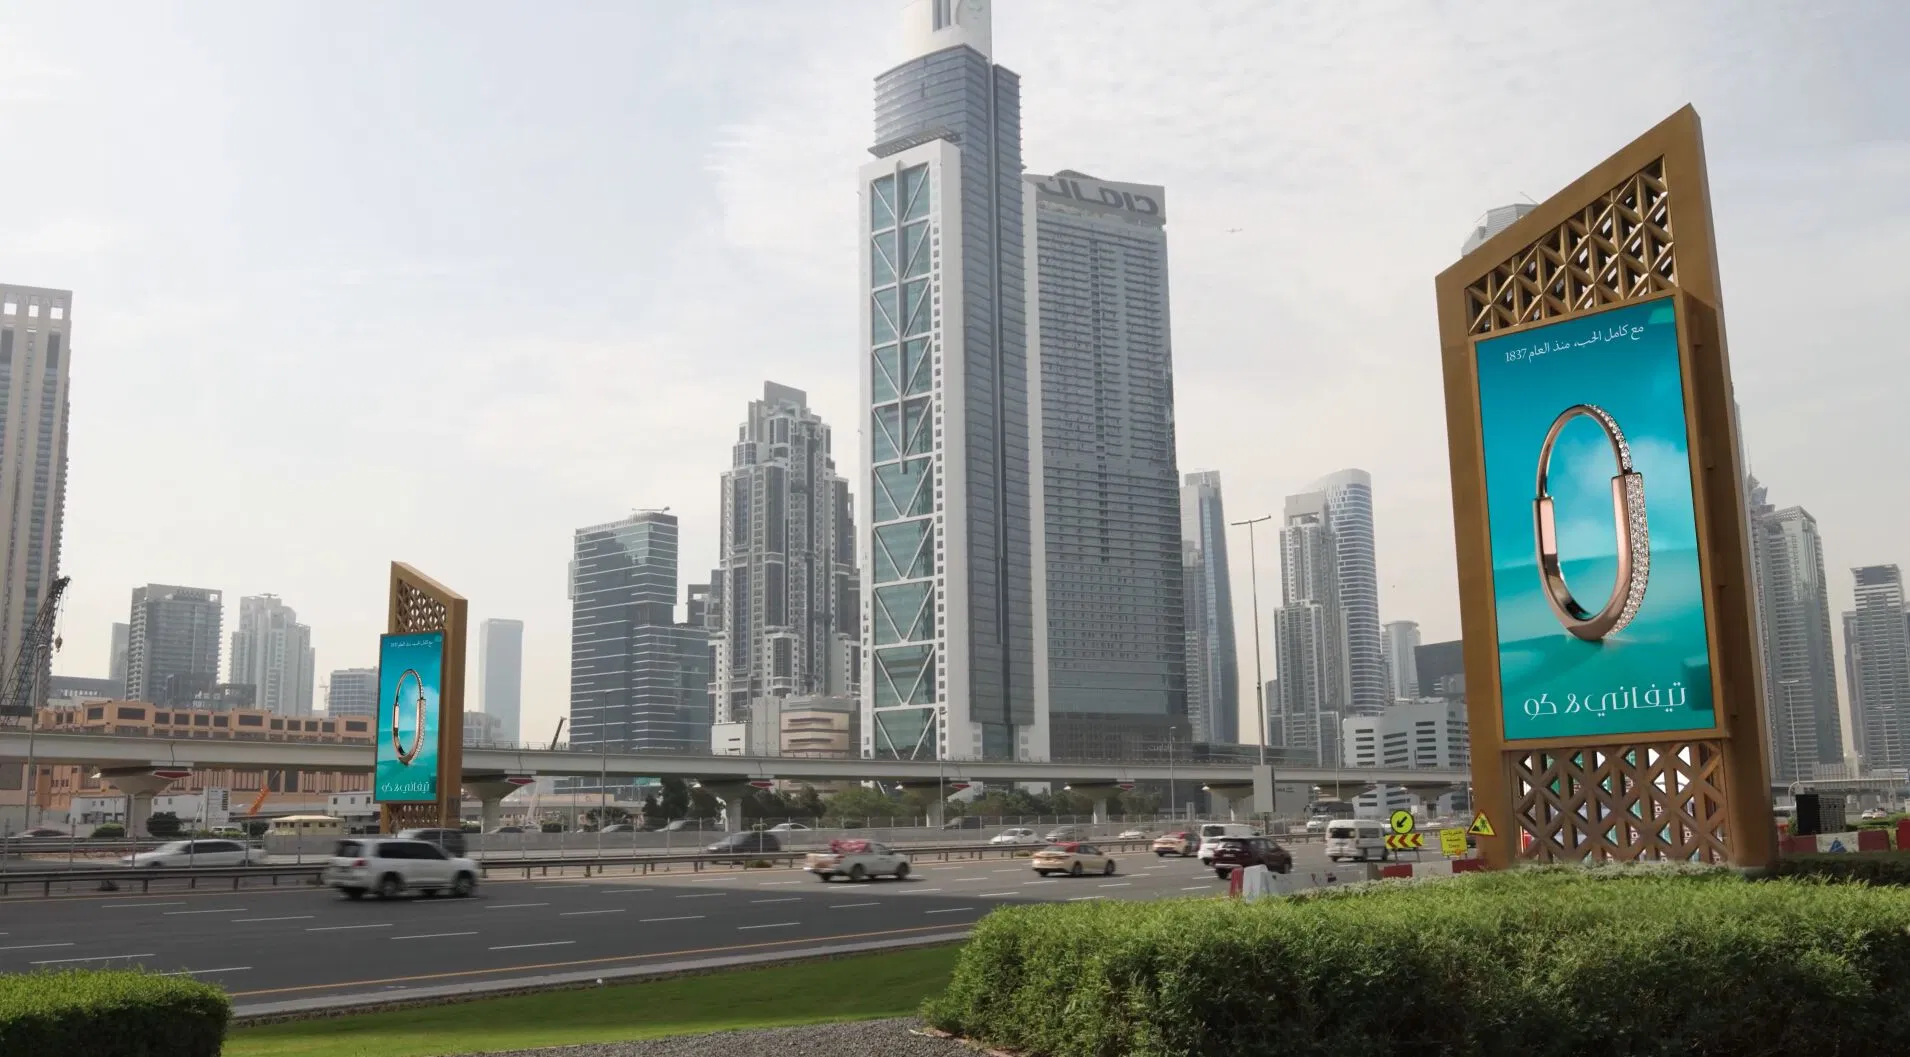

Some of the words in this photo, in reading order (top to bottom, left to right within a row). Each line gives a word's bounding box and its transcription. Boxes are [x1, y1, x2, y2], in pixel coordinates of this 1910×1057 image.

[1604, 324, 1629, 342] كامل
[1630, 325, 1645, 341] مع
[1528, 342, 1550, 363] العام
[1553, 340, 1571, 352] منذ
[1505, 348, 1528, 363] 1837
[1523, 693, 1558, 721] كو
[1584, 681, 1687, 717] تيفاني
